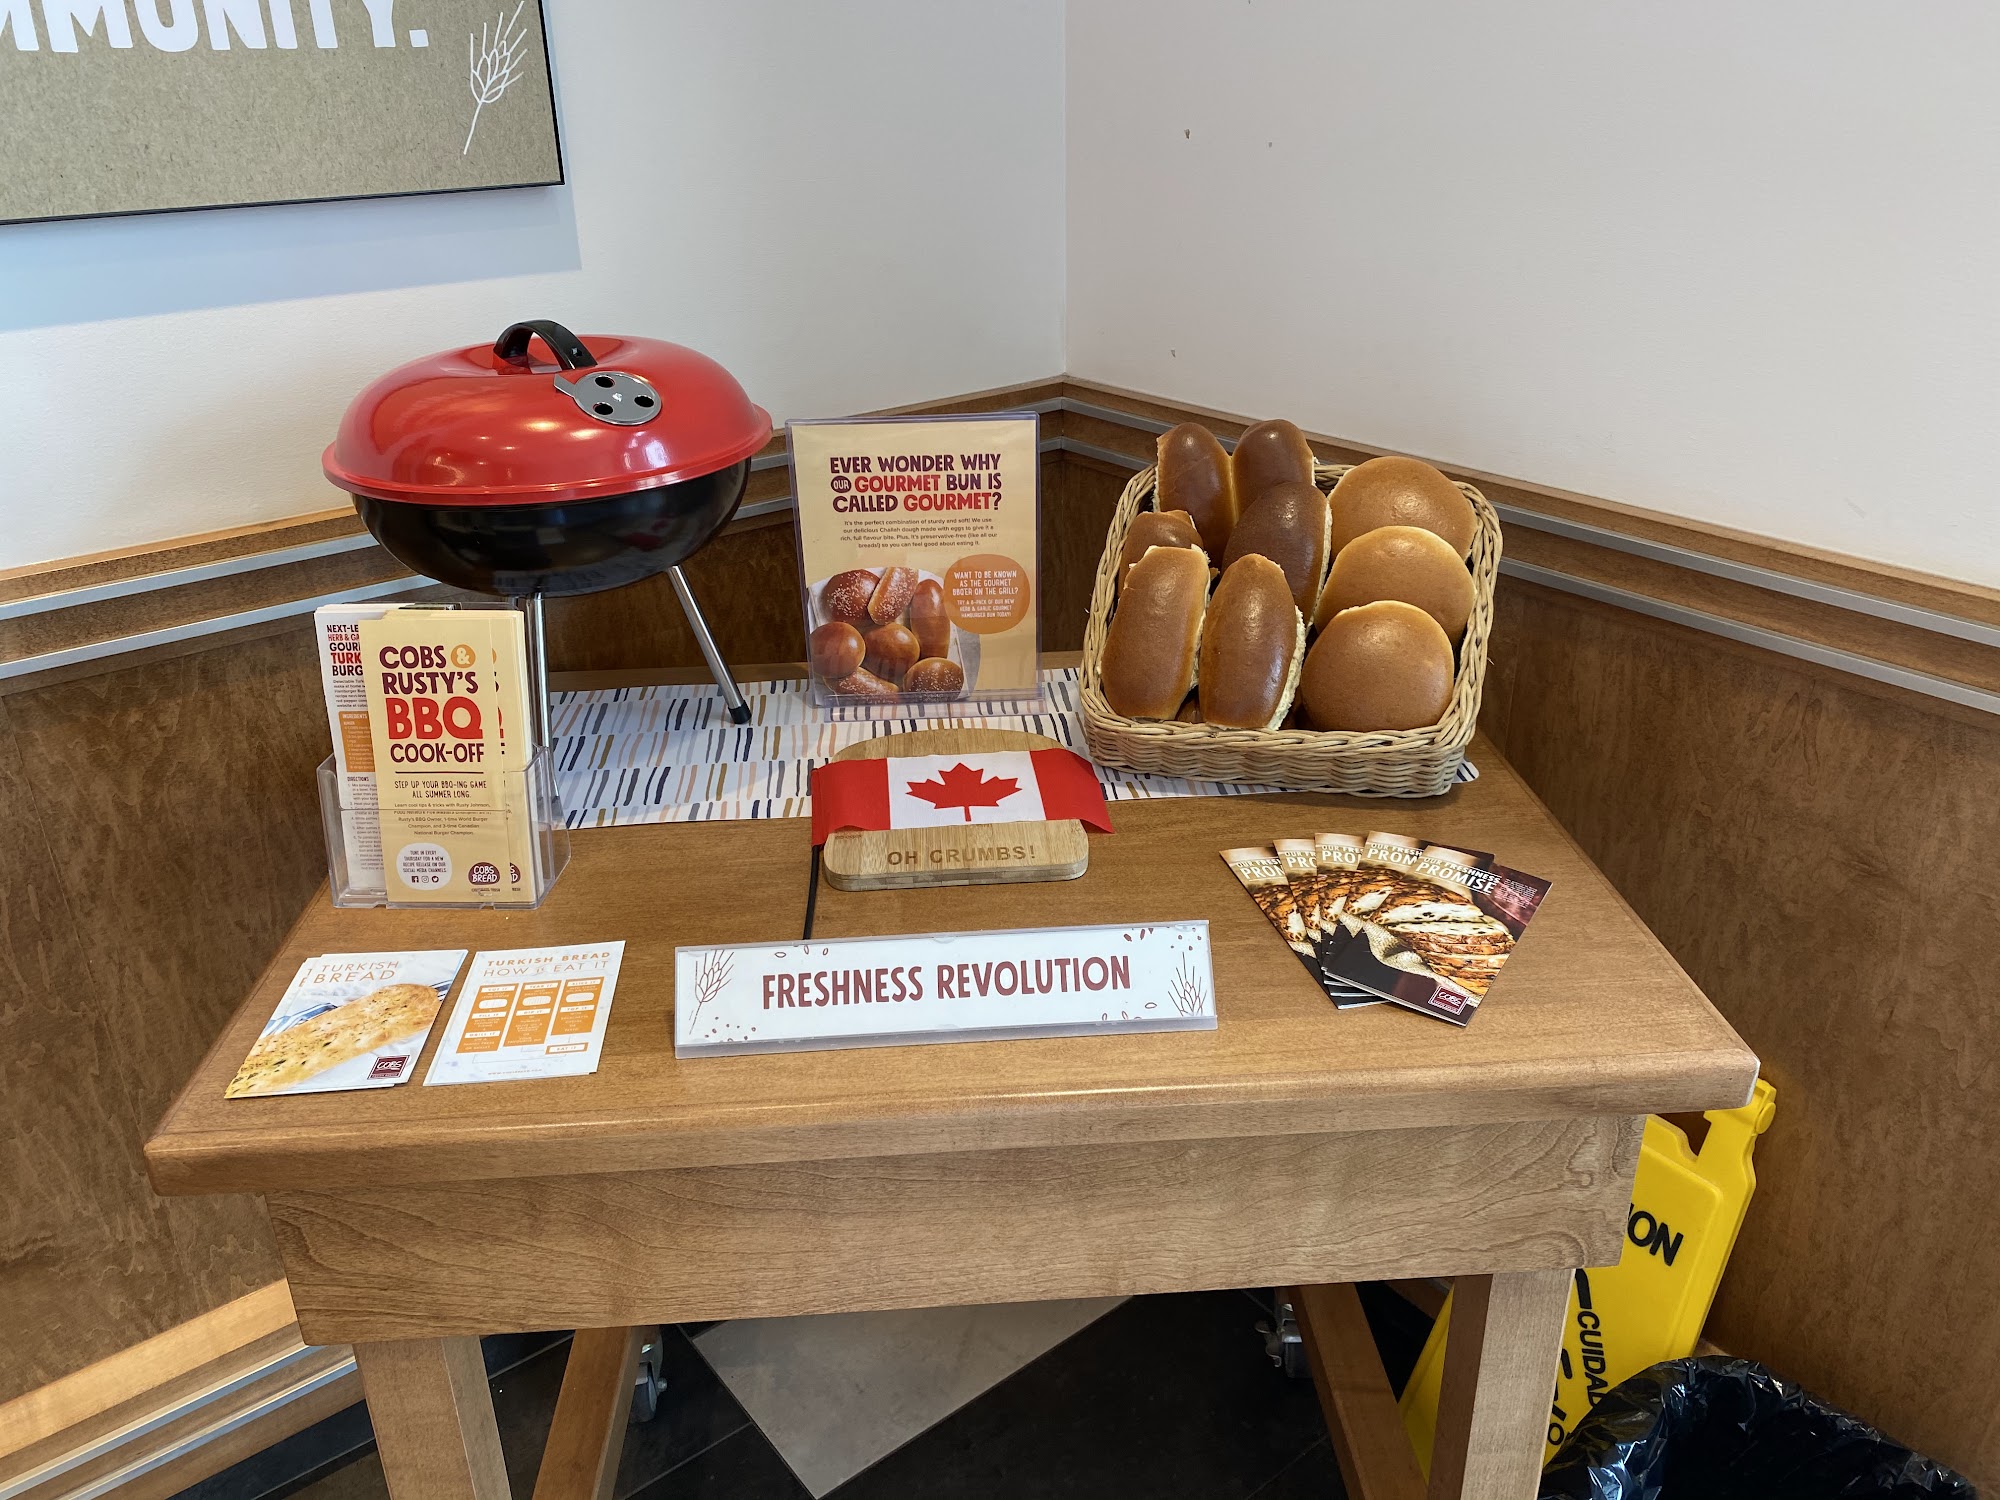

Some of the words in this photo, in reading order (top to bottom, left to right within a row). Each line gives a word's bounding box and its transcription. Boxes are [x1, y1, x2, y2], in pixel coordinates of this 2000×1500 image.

[830, 457, 872, 473] EVER
[878, 455, 954, 472] WONDER
[960, 454, 1001, 470] WHY
[833, 478, 849, 489] OUR
[855, 475, 941, 492] GOURMET
[946, 474, 981, 490] BUN
[988, 473, 1002, 489] IS
[833, 495, 898, 512] CALLED
[904, 492, 1002, 512] GOURMET?
[954, 571, 972, 579] WANT
[994, 570, 1017, 578] KNOWN
[984, 579, 1011, 587] GOURMET
[975, 587, 983, 595] ON
[985, 587, 996, 595] THE
[330, 642, 360, 651] GOUR
[331, 652, 362, 664] TURK
[380, 646, 446, 669] COBS
[456, 647, 470, 664] &
[332, 665, 363, 676] BURG
[382, 672, 478, 694] RUSTY'S
[386, 696, 483, 739] BBQ
[390, 743, 484, 762] COOK-OFF
[412, 790, 423, 798] ALL
[425, 790, 452, 798] SUMMER
[454, 790, 471, 798] LONG.
[887, 851, 918, 865] OH
[474, 866, 494, 874] COBS
[1424, 858, 1442, 866] OUR
[1444, 862, 1501, 883] FRESHNESS
[472, 874, 498, 882] BREAD
[1416, 862, 1496, 894] PROMISE
[322, 961, 399, 972] TURKISH
[487, 957, 554, 967] TURKISH
[561, 951, 610, 961] BREAD
[314, 970, 395, 983] BREAD
[483, 967, 529, 977] HOW
[554, 963, 584, 972] EAT
[595, 961, 609, 969] IT
[762, 965, 924, 1010] FRESHNESS
[936, 954, 1132, 1000] REVOLUTION
